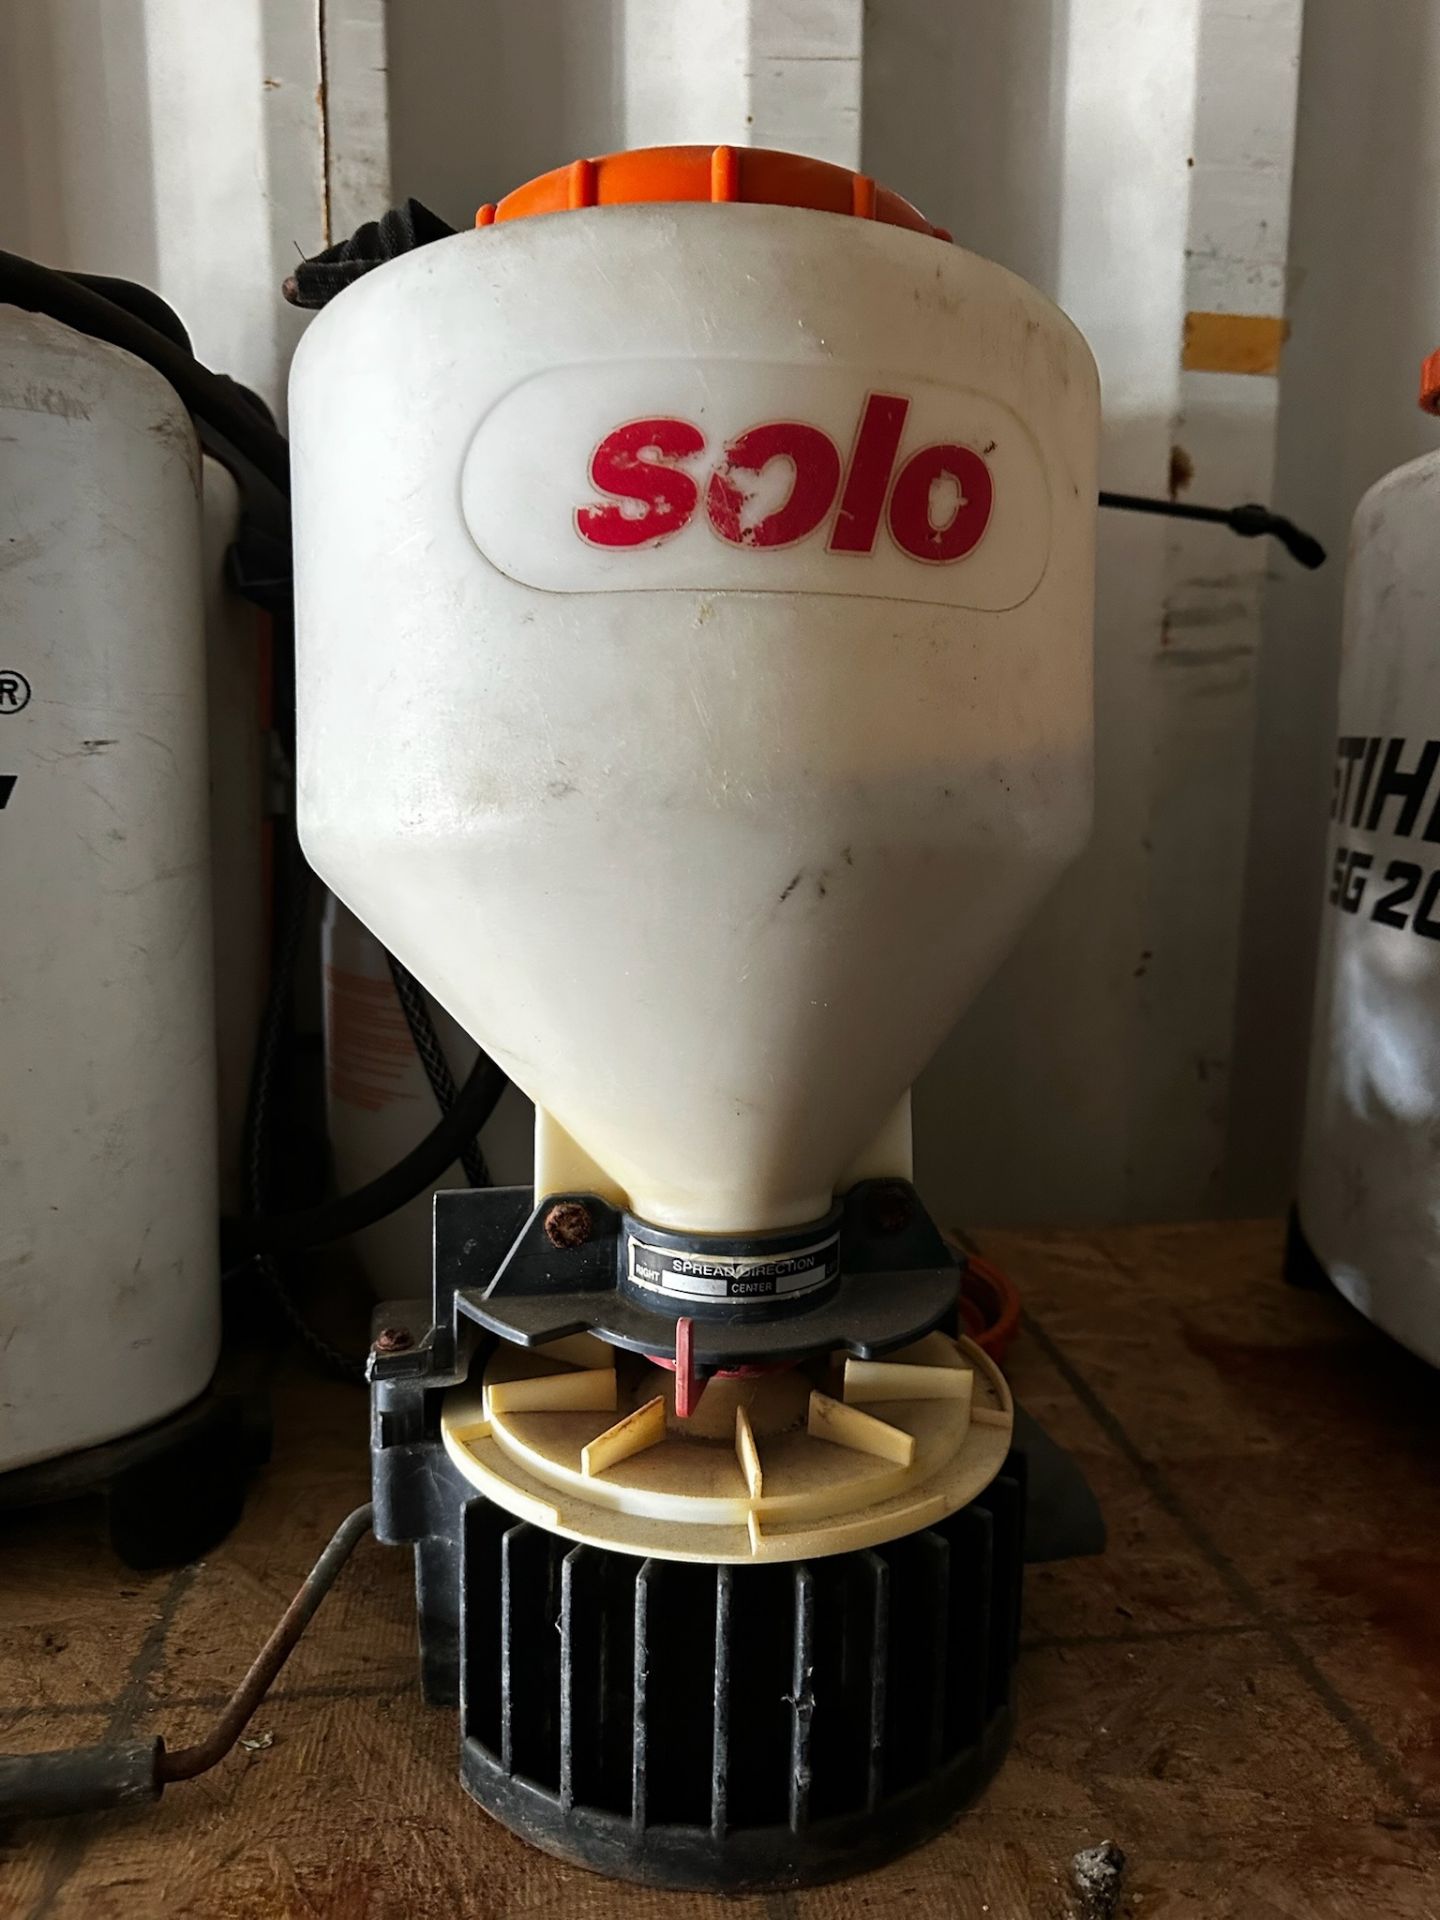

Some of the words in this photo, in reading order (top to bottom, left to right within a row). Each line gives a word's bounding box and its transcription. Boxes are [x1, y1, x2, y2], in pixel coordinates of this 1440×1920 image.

[573, 390, 994, 564] solo
[635, 1264, 660, 1281] RIGHT
[672, 1258, 735, 1278] SPREAD
[731, 1283, 773, 1294] CENTER
